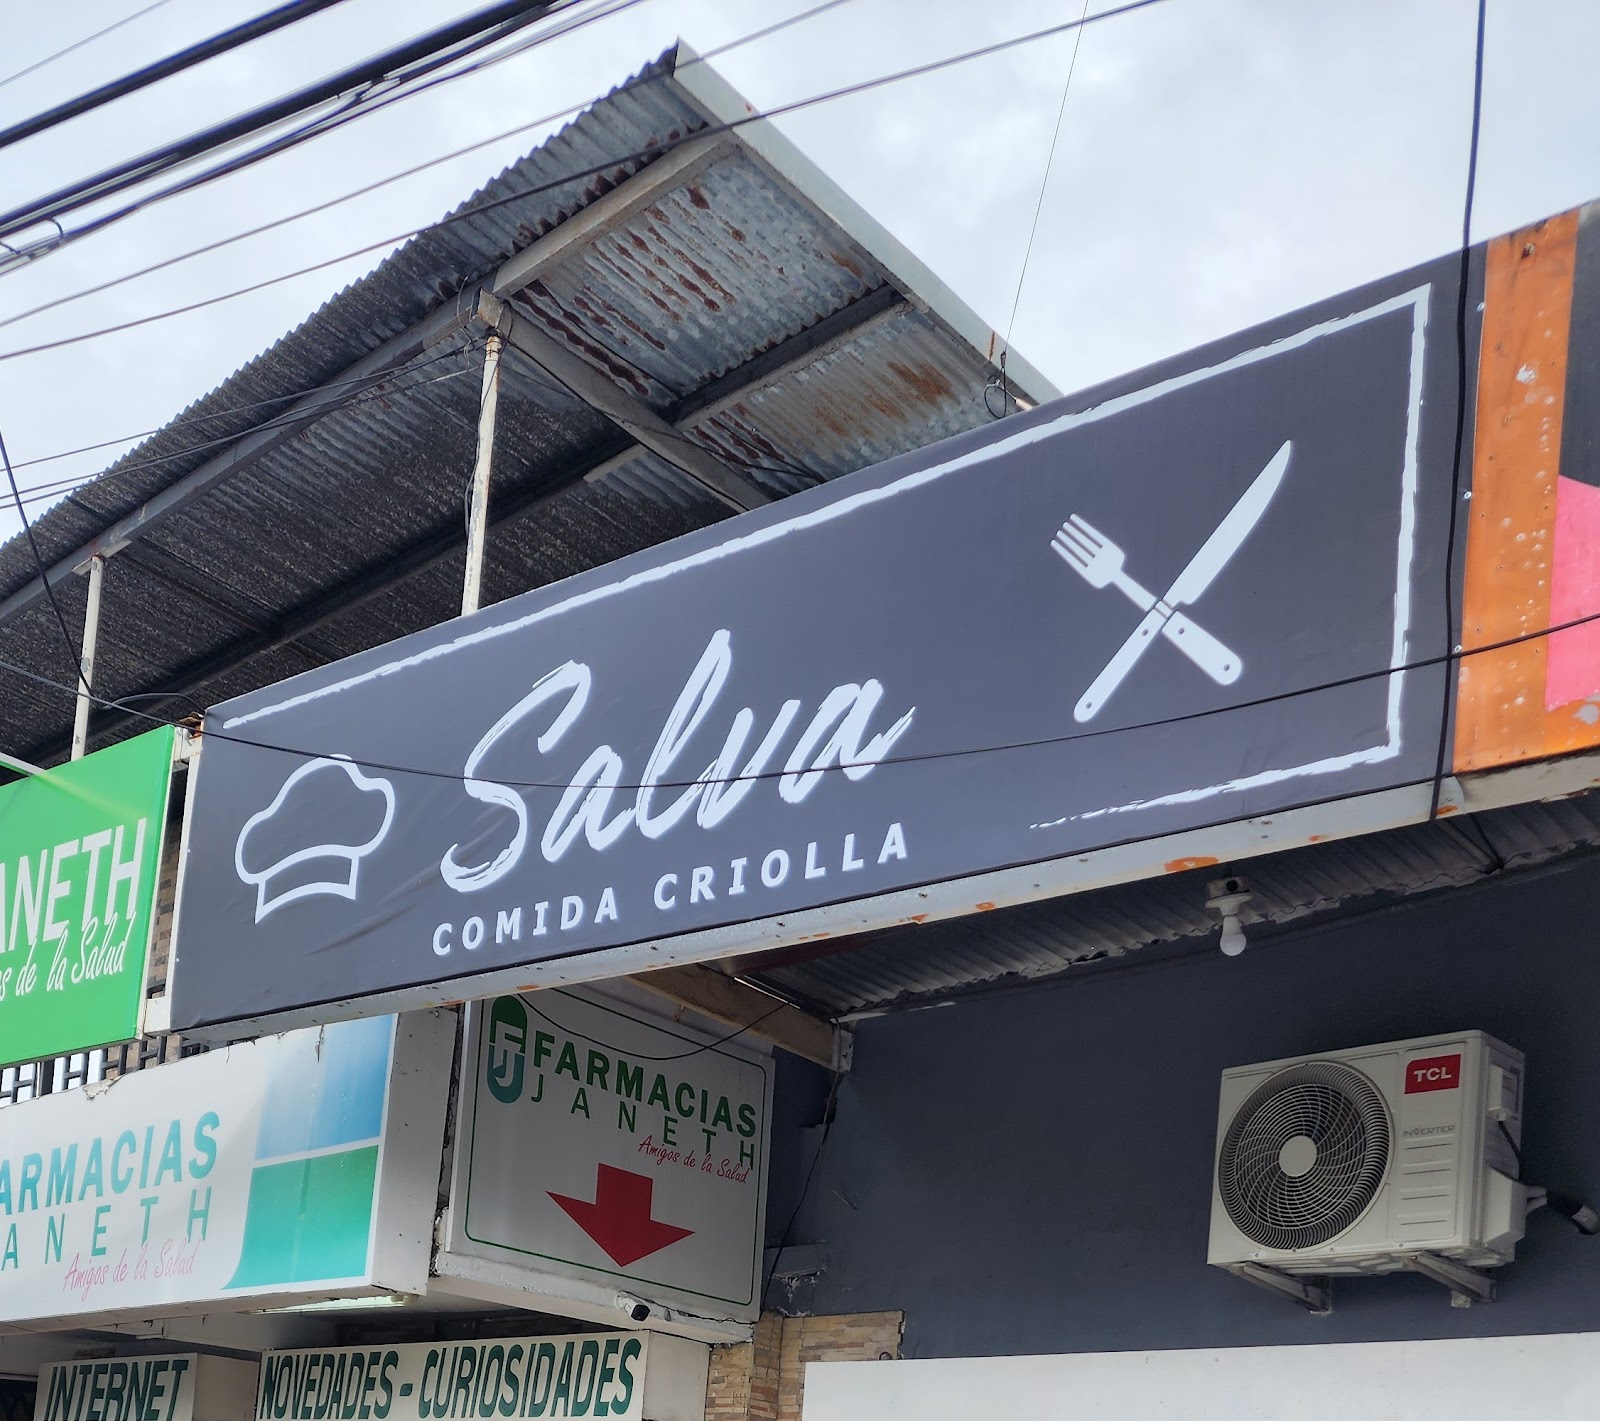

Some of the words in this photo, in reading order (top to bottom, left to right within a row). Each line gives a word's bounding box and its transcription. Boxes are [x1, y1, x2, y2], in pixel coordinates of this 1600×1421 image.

[440, 629, 916, 892] Salva
[433, 887, 619, 957] COMIDA
[653, 823, 908, 910] CRIOLLA
[15, 938, 36, 997] de
[46, 929, 69, 992] la
[71, 911, 137, 984] Salud
[533, 1031, 756, 1138] FARMACIAS
[1414, 1067, 1452, 1082] TCL
[531, 1074, 755, 1170] JANETH
[637, 1135, 680, 1166] Amigos
[683, 1150, 698, 1169] de
[701, 1154, 713, 1174] la
[717, 1159, 751, 1184] Salud
[1403, 1125, 1455, 1136] INVERTER
[62, 1252, 109, 1302] Amigos
[112, 1248, 128, 1284] de
[133, 1242, 149, 1281] la
[154, 1238, 201, 1279] Salud
[44, 1359, 189, 1421] INTERNET
[258, 1350, 399, 1420] NOVEDADES
[418, 1338, 642, 1419] CURIOSIDADES
